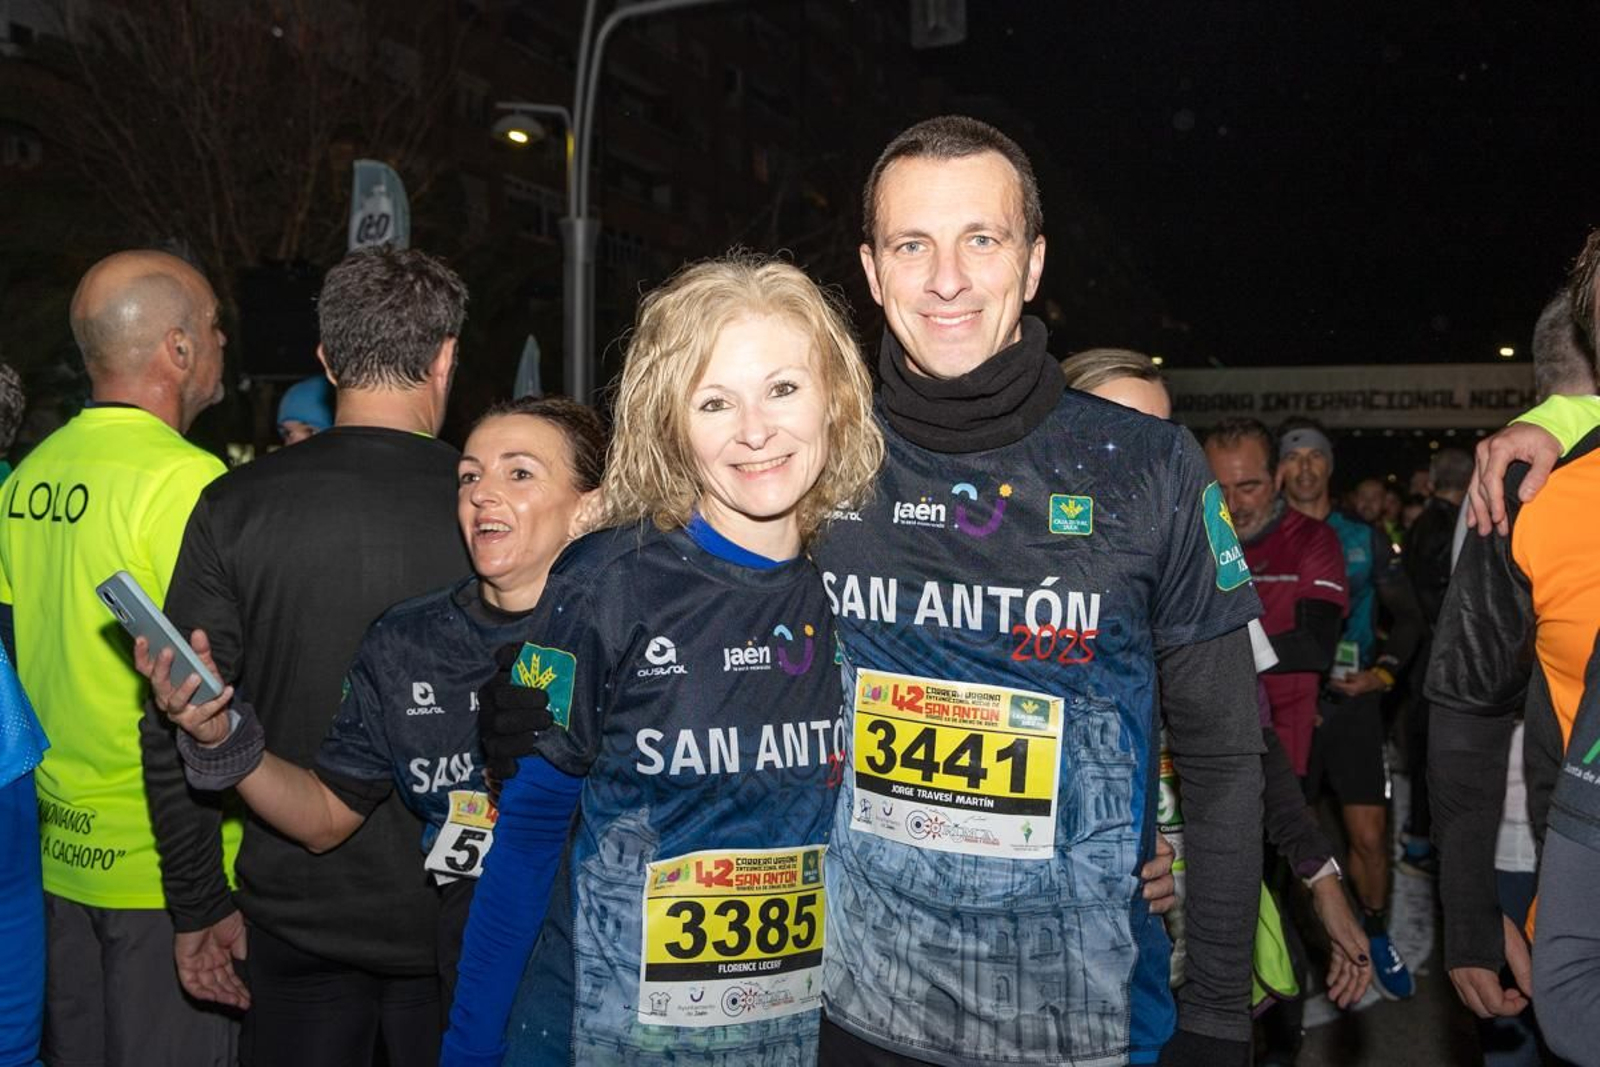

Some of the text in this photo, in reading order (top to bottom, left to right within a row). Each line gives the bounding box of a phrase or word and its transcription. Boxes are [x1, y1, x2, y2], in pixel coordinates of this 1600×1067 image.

[1260, 389, 1463, 412] INTERNACIONAL
[1468, 388, 1537, 409] NOCH
[8, 480, 89, 524] LOLO
[823, 571, 1101, 639] SAN ANTÓN
[1010, 624, 1100, 664] 2025
[891, 684, 925, 714] 42
[925, 702, 950, 717] SAN
[952, 705, 1000, 723] ANTON
[635, 704, 846, 776] SAN ANTÓ
[865, 719, 1029, 794] 3441
[409, 752, 475, 793] SAN
[891, 785, 914, 797] JORGE
[956, 794, 994, 808] MARTÍN
[444, 828, 487, 873] 5
[695, 858, 734, 888] 42
[735, 873, 761, 886] SAN
[763, 870, 797, 884] ANTON
[664, 893, 817, 960] 3385
[718, 959, 782, 974] FLORENCE LECERF
